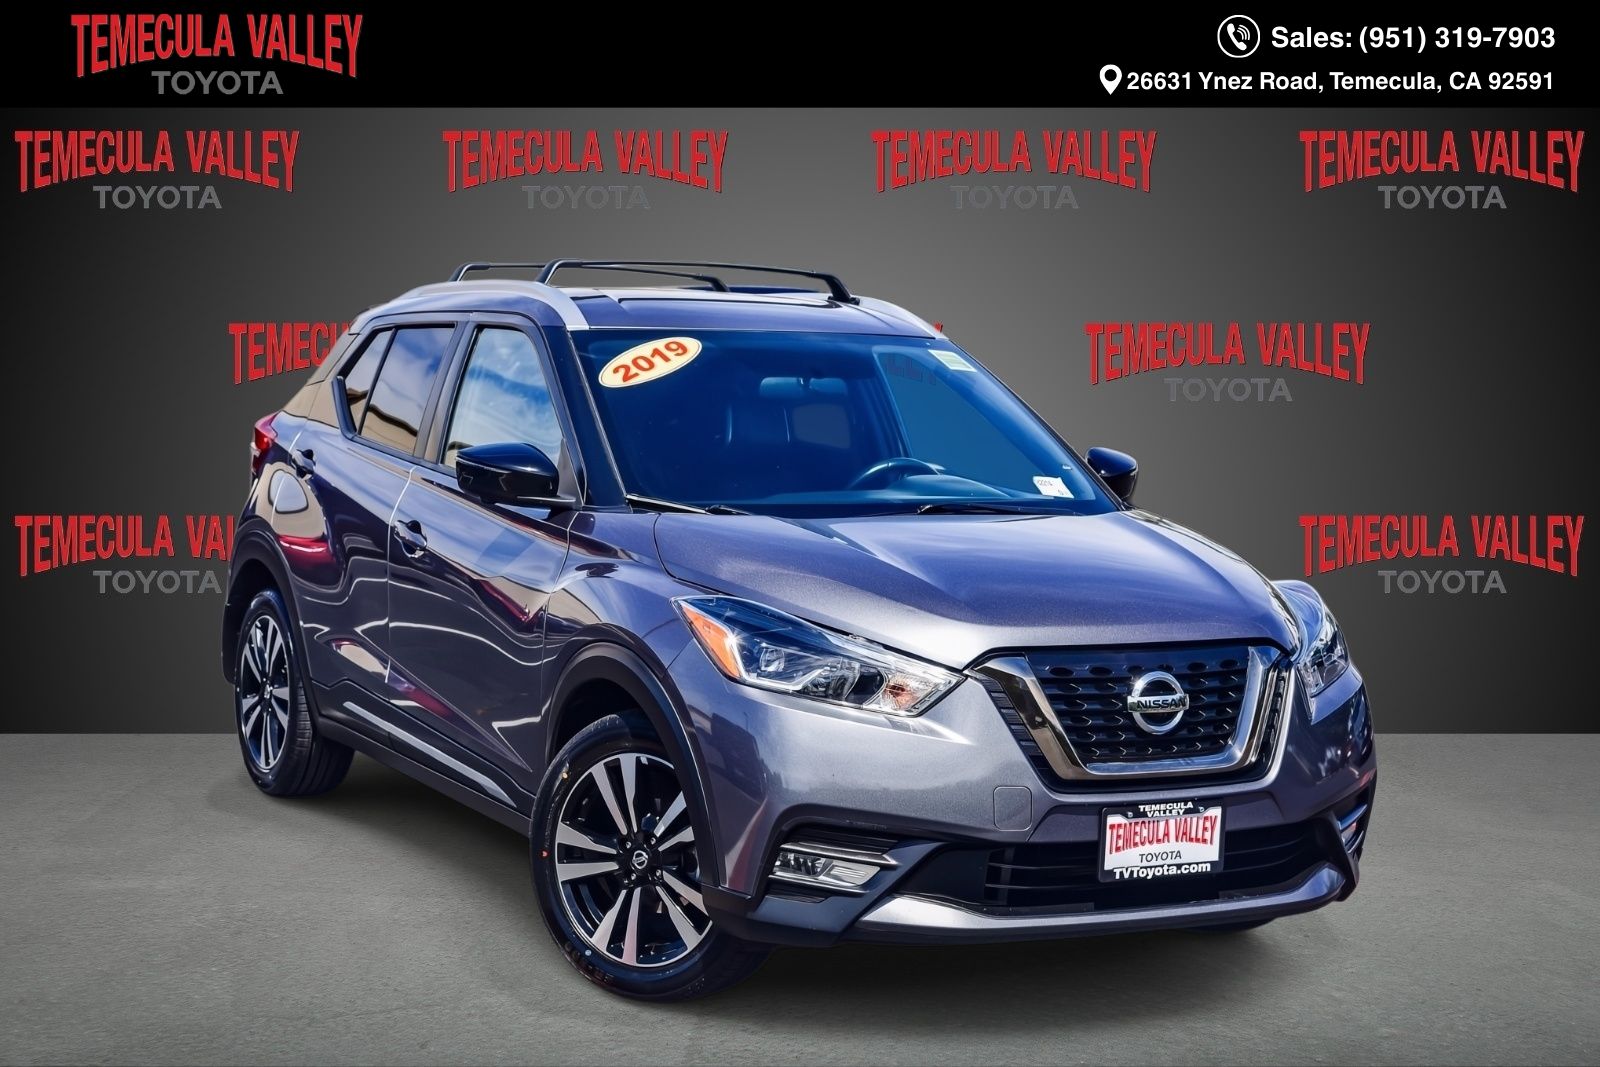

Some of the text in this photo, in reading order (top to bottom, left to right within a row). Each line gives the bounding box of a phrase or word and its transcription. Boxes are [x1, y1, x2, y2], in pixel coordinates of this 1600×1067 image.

[14, 130, 299, 192] TEMECULA VALLEY
[442, 130, 727, 192] TEMECULA VALLEY
[871, 130, 1156, 192] TEMECULA VALLEY
[1299, 130, 1584, 192] TEMECULA VALLEY
[93, 185, 223, 209] TOYOTA
[521, 185, 651, 209] TOYOTA
[950, 185, 1080, 209] TOYOTA
[1378, 185, 1508, 209] TOYOTA
[228, 322, 350, 385] TEMEC
[612, 340, 688, 383] 2019
[1085, 322, 1370, 384] TEMECULA VALLEY
[1164, 378, 1293, 401] TOYOTA
[14, 515, 174, 577] TEMECULA
[1299, 515, 1584, 577] TEMECULA VALLEY
[93, 570, 222, 594] TOYOTA
[1378, 570, 1507, 594] TOYOTA
[1136, 696, 1187, 710] NISSAN
[1138, 801, 1194, 812] TEMECULA
[1146, 808, 1185, 818] VALLEY
[1109, 815, 1218, 855] TEMECULA VALLEY
[1139, 850, 1182, 863] TOYOTA
[1113, 863, 1211, 879] TVToyota.com
